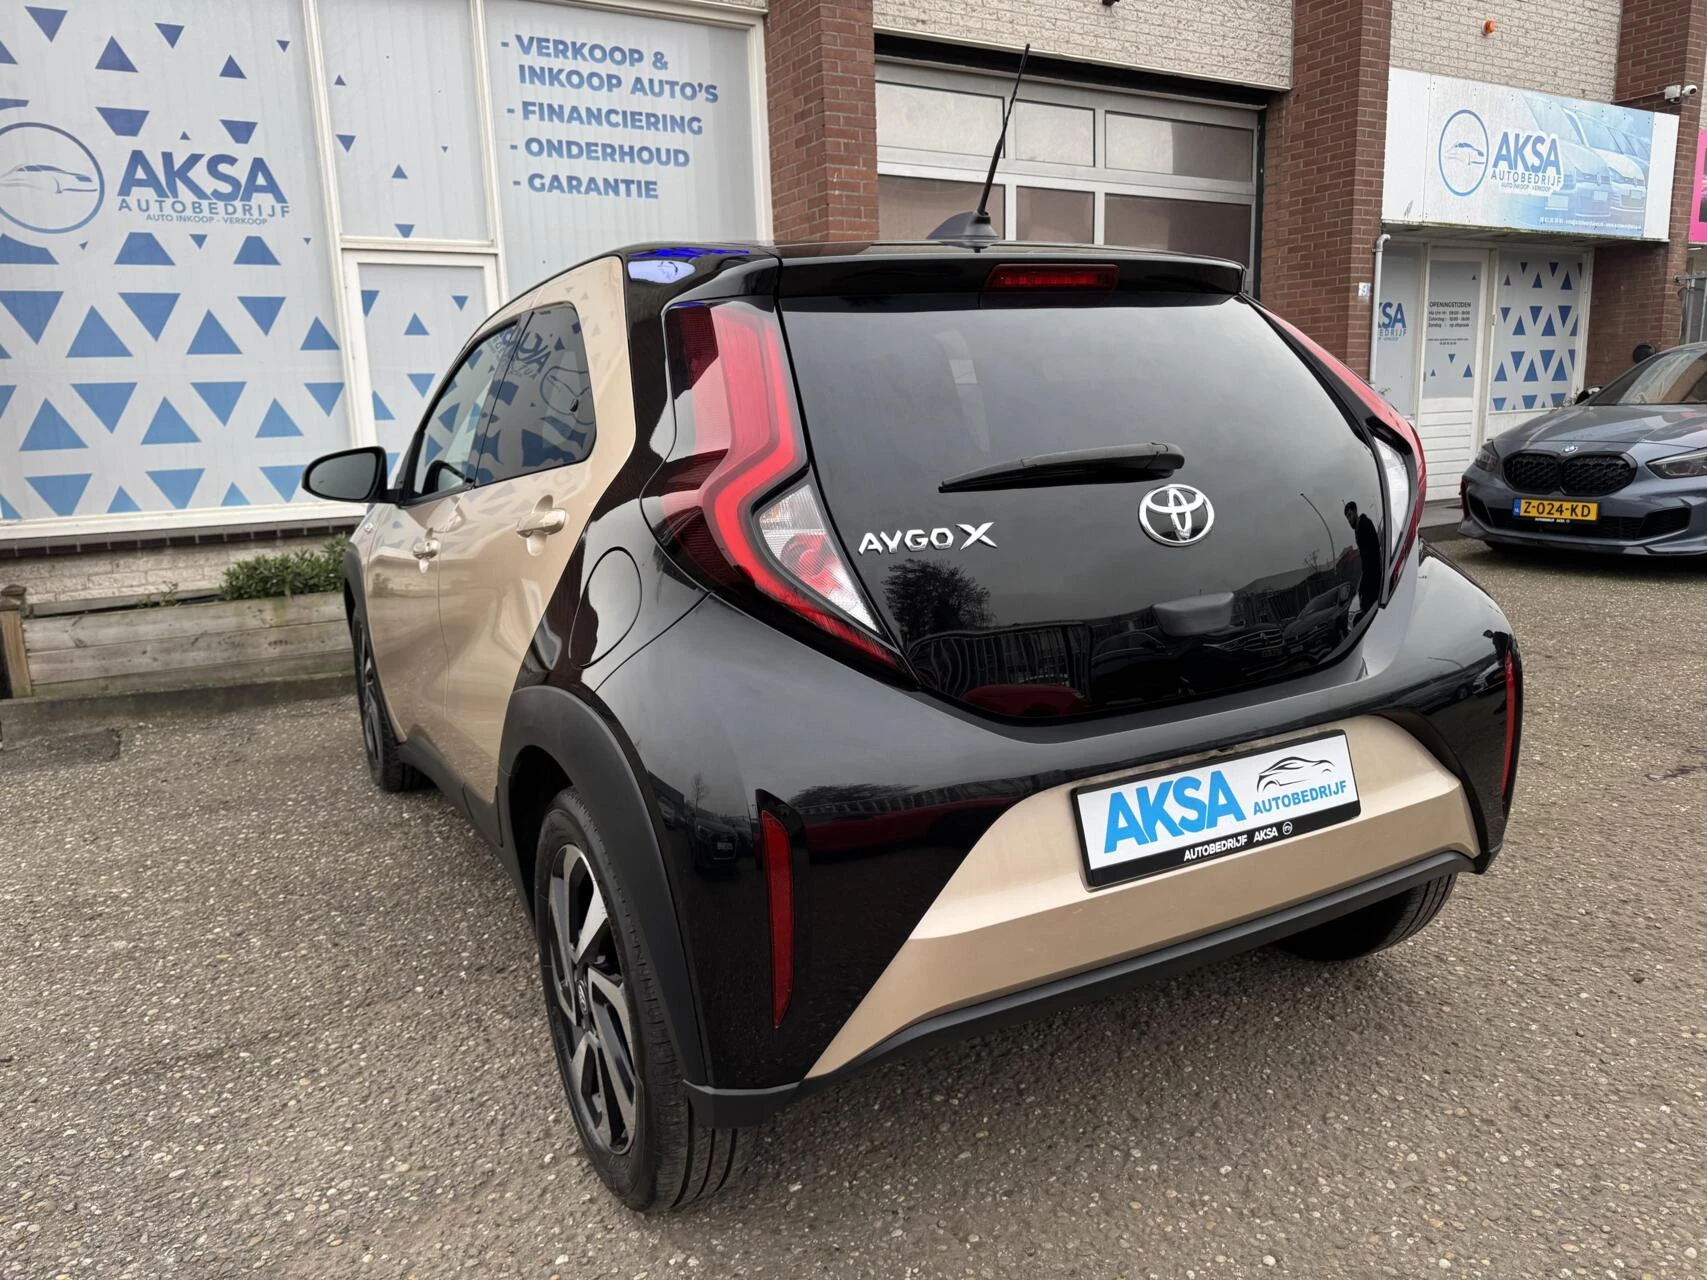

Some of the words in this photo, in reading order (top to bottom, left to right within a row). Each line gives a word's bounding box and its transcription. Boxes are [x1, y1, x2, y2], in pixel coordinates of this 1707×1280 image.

[515, 34, 644, 67] VERKOOP
[652, 51, 669, 70] &
[518, 64, 623, 92] INKOOP
[630, 77, 719, 103] AUTO'S
[521, 101, 703, 135] FINANCIERING
[524, 137, 690, 167] ONDERHOUD
[1492, 131, 1562, 176] AKSA
[117, 150, 288, 204] AKSA
[527, 173, 659, 199] GARANTIE
[1490, 171, 1562, 187] AUTOBEDRIJF
[118, 198, 291, 219] AUTOBEDRIJF
[146, 213, 173, 222] AUTO
[176, 215, 215, 223] INKOOP
[223, 217, 268, 226] VERKOOP
[1523, 501, 1590, 518] Z-024-KD
[858, 527, 954, 555] AYGO
[955, 521, 998, 550] X
[1103, 770, 1247, 854] AKSA
[1253, 780, 1347, 816] AUTOBEDRIJF
[1184, 835, 1248, 861] AUTOBEDRIJF
[1253, 826, 1279, 843] AKSA
